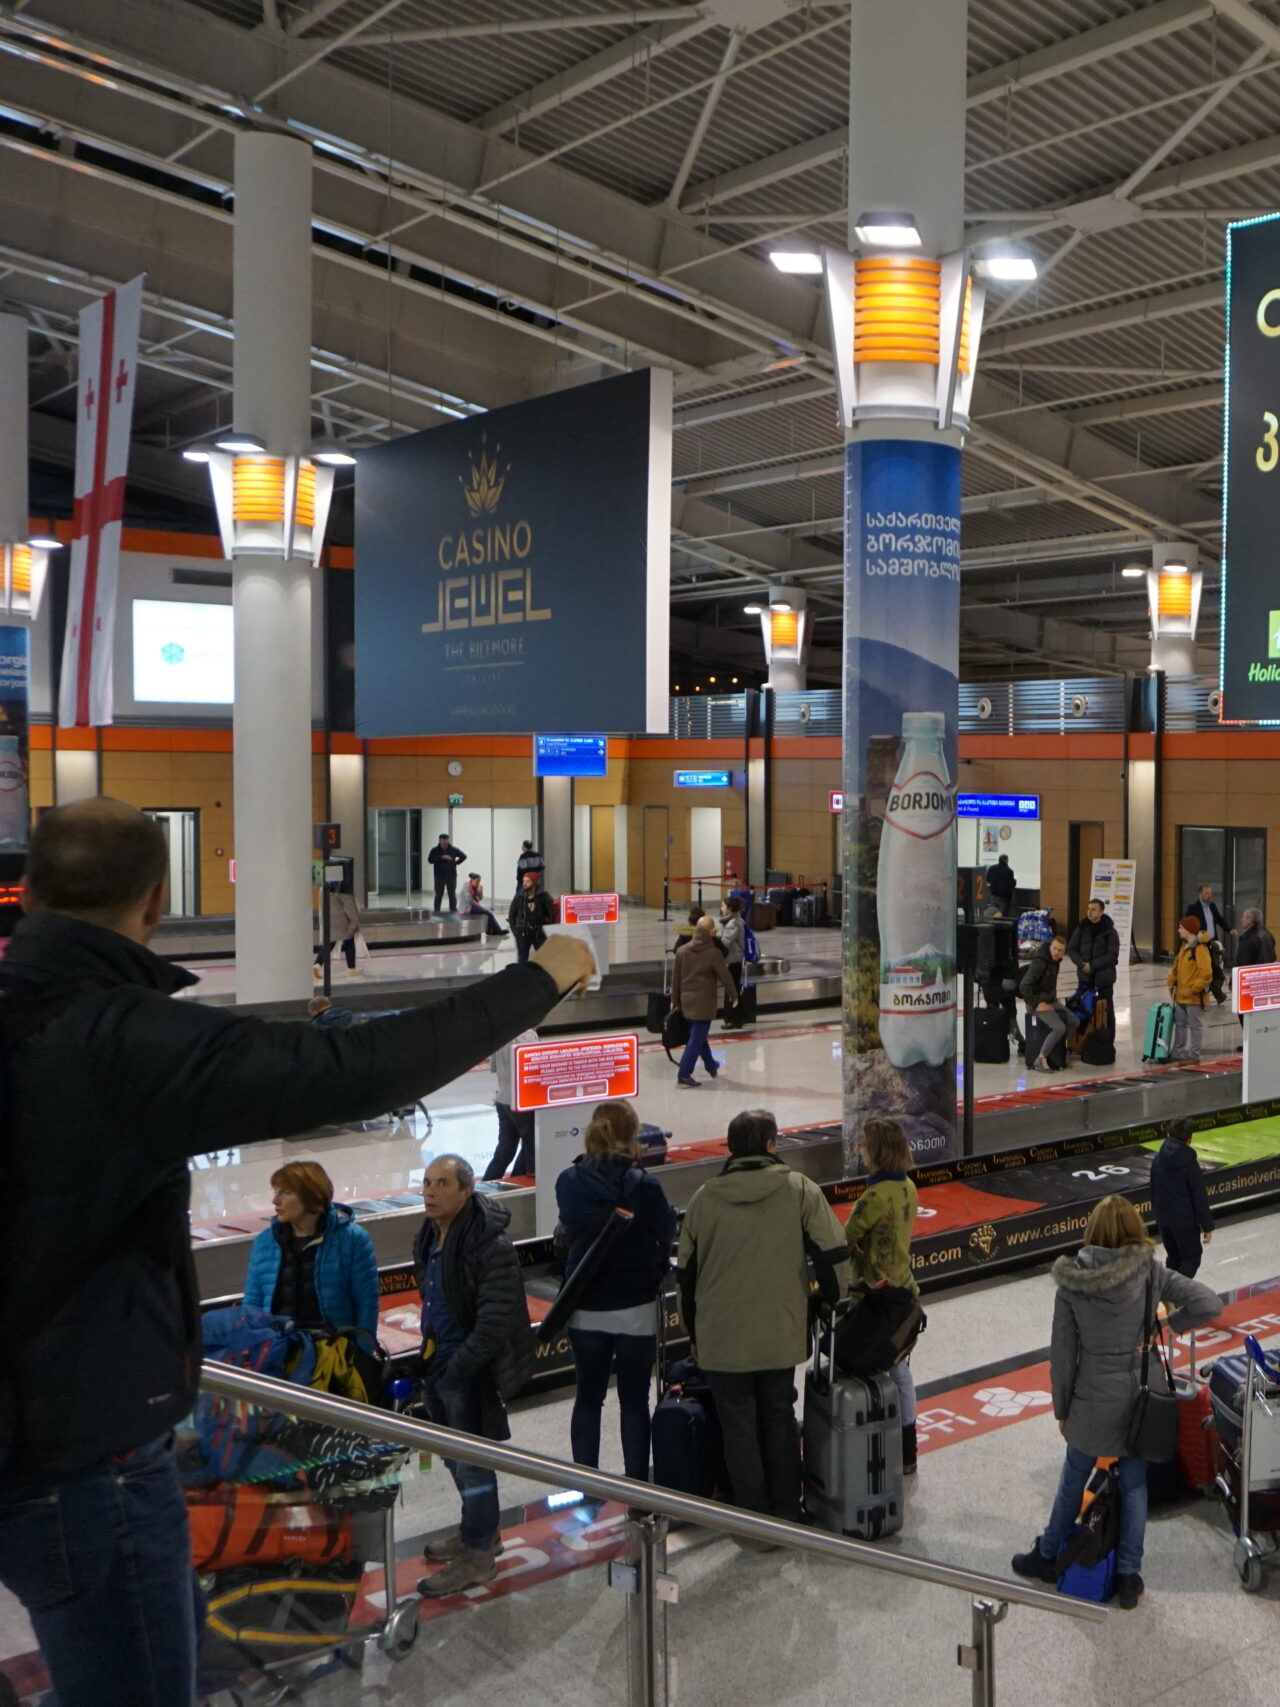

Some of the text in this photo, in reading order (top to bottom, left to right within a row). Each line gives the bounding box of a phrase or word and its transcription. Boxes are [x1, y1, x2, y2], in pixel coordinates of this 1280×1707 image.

[438, 520, 532, 571] CASINO
[421, 567, 552, 633] JEWEL
[444, 637, 525, 660] THE BILTMORE
[328, 829, 336, 844] 3
[976, 875, 984, 900] 2
[1072, 1164, 1131, 1181] 26
